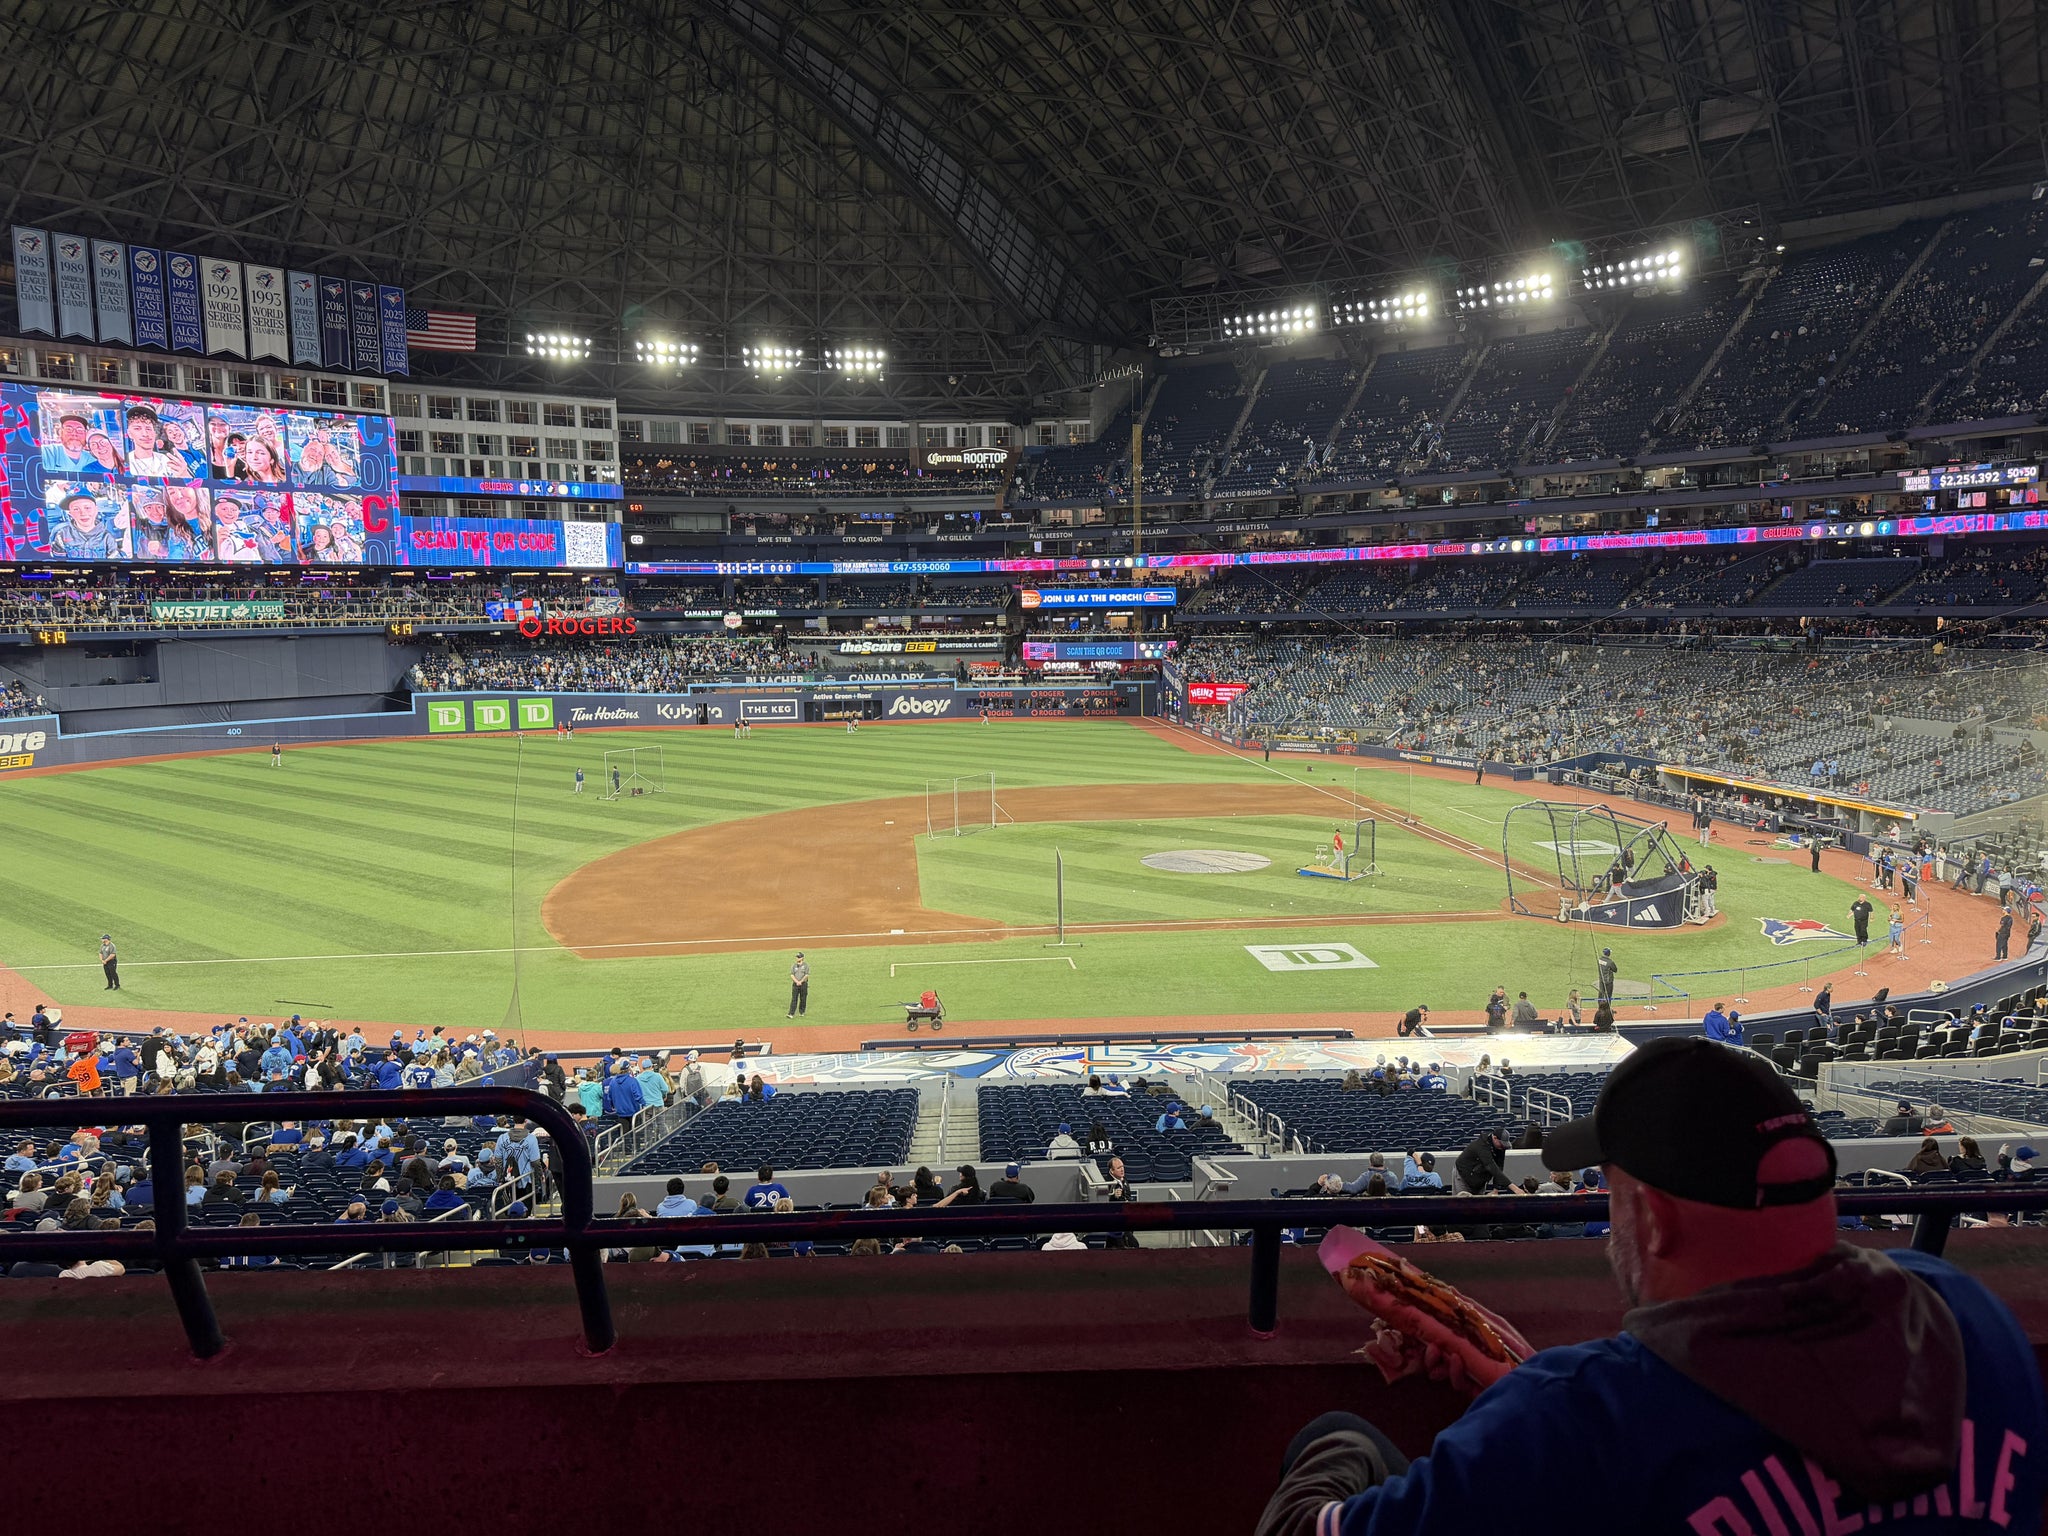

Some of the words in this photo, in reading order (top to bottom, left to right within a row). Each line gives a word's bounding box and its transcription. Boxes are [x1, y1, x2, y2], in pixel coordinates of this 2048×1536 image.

[20, 255, 44, 268] 1985
[20, 269, 46, 277] AMERICAN
[60, 262, 84, 274] 1989
[100, 268, 121, 279] 1991
[20, 275, 47, 285] LEAGUE
[61, 275, 86, 283] AMERICAN
[136, 273, 159, 285] 1992
[20, 283, 47, 295] EAST
[61, 281, 86, 291] LEAGUE
[172, 278, 195, 291] 1993
[61, 289, 86, 300] EAST
[100, 287, 124, 297] LEAGUE
[136, 286, 160, 294] AMERICAN
[172, 291, 196, 299] AMERICAN
[207, 284, 238, 300] 1992
[21, 293, 48, 303] CHAMPS
[101, 295, 124, 306] EAST
[136, 292, 161, 302] LEAGUE
[172, 297, 196, 307] LEAGUE
[252, 290, 282, 306] 1993
[295, 296, 314, 307] 2015
[62, 299, 88, 308] CHAMPS
[101, 304, 126, 313] CHAMPS
[137, 300, 161, 311] EAST
[207, 300, 240, 313] WORLD
[325, 301, 344, 311] 2016
[137, 309, 162, 318] CHAMPS
[173, 305, 196, 316] EAST
[252, 306, 283, 319] WORLD
[384, 309, 403, 320] 2025
[173, 314, 197, 323] CHAMPS
[208, 311, 242, 323] SERIES
[325, 313, 346, 323] ALDS
[355, 312, 375, 322] 2016
[139, 321, 164, 332] ALCS
[208, 322, 242, 331] CHAMPIONS
[252, 317, 284, 329] SERIES
[295, 321, 315, 331] EAST
[325, 322, 346, 330] CHAMPS
[175, 326, 198, 337] ALCS
[253, 326, 285, 336] CHAMPIONS
[295, 329, 316, 338] CHAMPS
[355, 325, 376, 335] 2020
[385, 326, 404, 334] LEAGUE
[139, 331, 164, 340] CHAMPS
[175, 336, 200, 344] CHAMPS
[385, 333, 404, 342] EAST
[296, 341, 318, 351] ALDS
[357, 338, 378, 349] 2022
[385, 341, 405, 349] CHAMPS
[358, 352, 378, 362] 2023
[386, 352, 406, 362] ALCS
[386, 360, 406, 369] CHAMPS
[928, 452, 962, 465] Corona
[964, 453, 1007, 463] ROOFTOP
[1906, 476, 1930, 485] WINNER
[1940, 472, 2000, 487] $2,251,392
[1238, 489, 1272, 497] ROBINSON
[1216, 524, 1233, 532] JOSÉ
[1763, 528, 1802, 538] @BLUEJAYS
[413, 530, 457, 549] SCAN
[518, 533, 556, 551] CODE
[1433, 544, 1465, 554] @BLUEJAYS
[893, 563, 950, 571] 647-559-0060
[1091, 594, 1106, 602] THE
[1109, 594, 1142, 602] PORCH!
[155, 605, 230, 620] WESTJET
[253, 605, 283, 613] FLIGHT
[392, 624, 412, 635] 4:19
[548, 617, 636, 635] ROGERS
[40, 632, 66, 644] 4:19
[840, 642, 902, 652] theScore
[1067, 647, 1084, 656] SCAN
[1084, 647, 1095, 656] THE
[1096, 647, 1105, 656] QR
[1106, 647, 1122, 655] CODE
[1191, 688, 1214, 698] HEINZ
[747, 706, 768, 714] THE
[771, 705, 792, 713] KEG
[889, 696, 951, 716] Sobeys
[432, 707, 461, 726] TD
[477, 705, 506, 724] TD
[521, 704, 549, 722] TD
[571, 707, 597, 721] Tim
[1244, 740, 1262, 749] HEINZ
[1336, 744, 1358, 752] HEINZ
[1436, 758, 1462, 766] BASELINE
[1261, 948, 1354, 965] TD
[754, 1190, 780, 1207] 29
